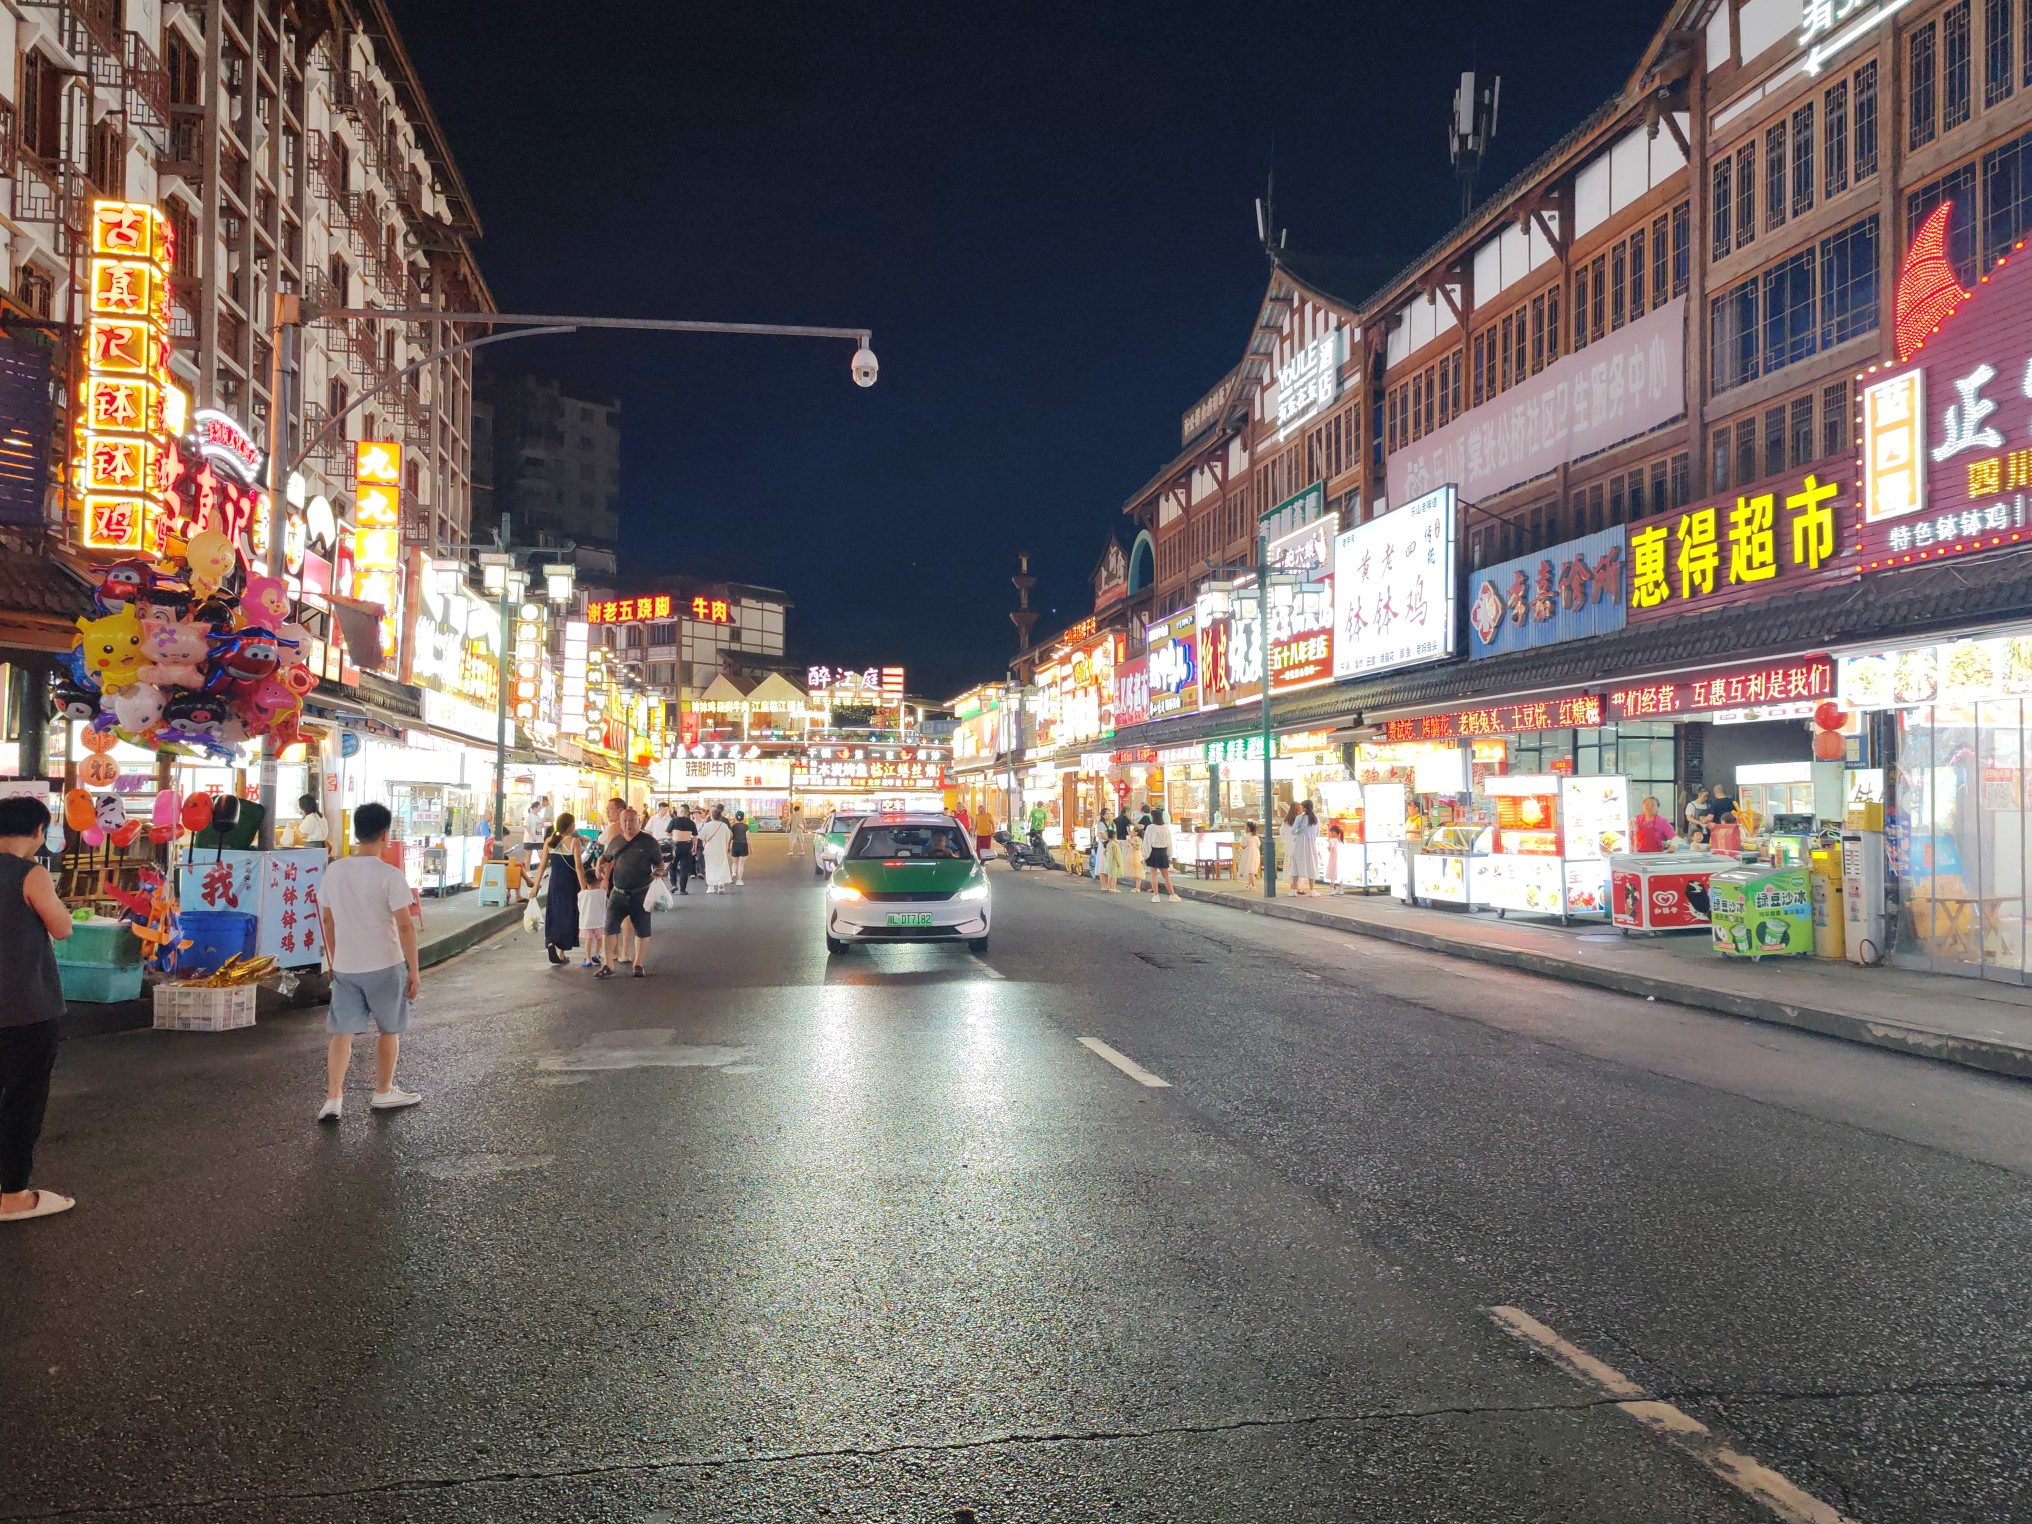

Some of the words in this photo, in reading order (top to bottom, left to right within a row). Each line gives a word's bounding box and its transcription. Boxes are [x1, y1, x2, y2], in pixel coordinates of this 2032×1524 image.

[1799, 0, 1862, 46] 有
[92, 206, 145, 545] 古真记钵钵鸡
[1278, 339, 1318, 391] YOULE
[1318, 336, 1335, 405] 酒店
[1631, 473, 1839, 609] 惠得超市
[1888, 501, 2009, 552] 特色钵钵鸡
[1357, 540, 1417, 584] 黄老四
[588, 595, 671, 624] 谢老五跷脚
[692, 596, 728, 624] 牛肉
[1345, 574, 1429, 644] 钵钵鸡
[1506, 545, 1625, 629] 李嘉诊所
[807, 665, 883, 691] 醉江庭
[90, 759, 118, 782] 福
[685, 760, 736, 778] 跷脚牛肉
[201, 862, 239, 910] 我
[270, 861, 280, 891] 乐山
[280, 861, 299, 955] 的钵钵鸡
[303, 866, 321, 953] 一元一串
[1712, 898, 1746, 915] 绿豆沙冰
[1755, 889, 1808, 910] 绿豆沙冰
